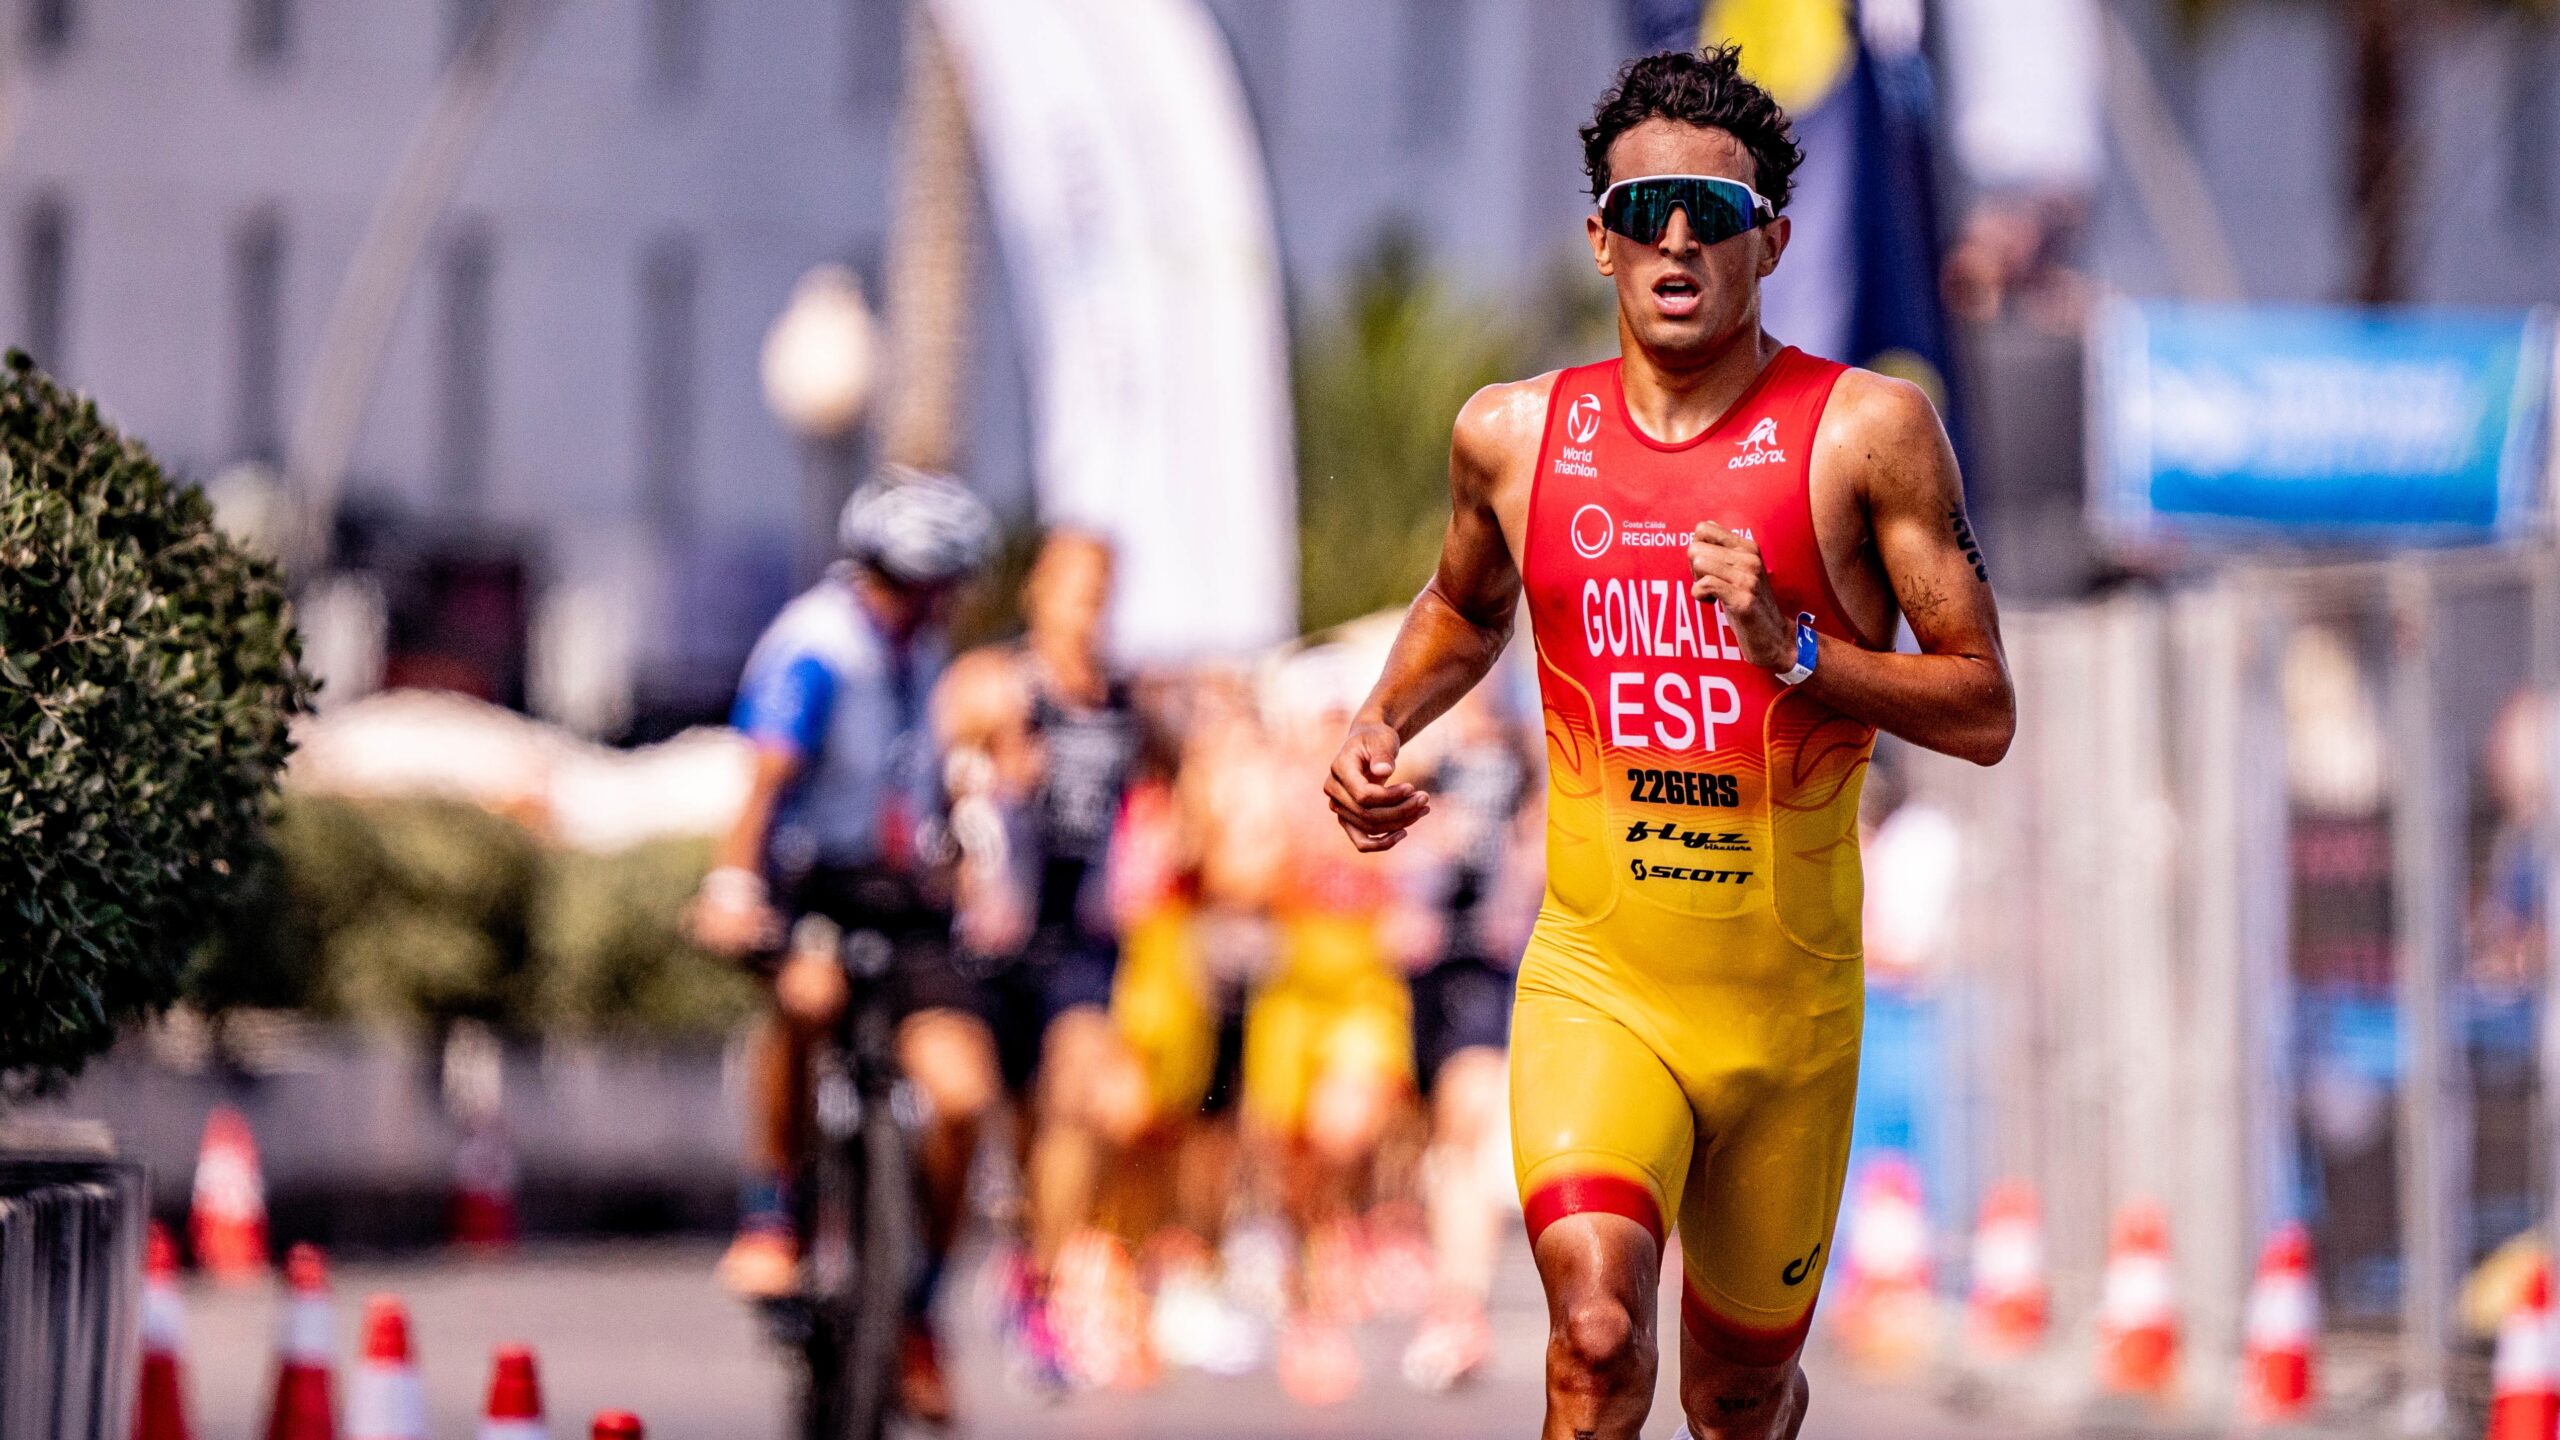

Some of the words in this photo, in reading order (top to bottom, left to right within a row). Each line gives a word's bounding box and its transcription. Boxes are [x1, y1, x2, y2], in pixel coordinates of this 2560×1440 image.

[1563, 445, 1593, 463] World
[1728, 449, 1786, 469] austral
[1554, 459, 1598, 478] Triathlon
[1622, 520, 1643, 529] Costa
[1644, 521, 1666, 529] Cálida
[1621, 530, 1676, 547] REGIÓN
[1582, 577, 1749, 662] GONZALE
[1610, 672, 1741, 752] ESP
[1627, 768, 1739, 808] 226ERS
[1648, 865, 1753, 884] SCOTT
